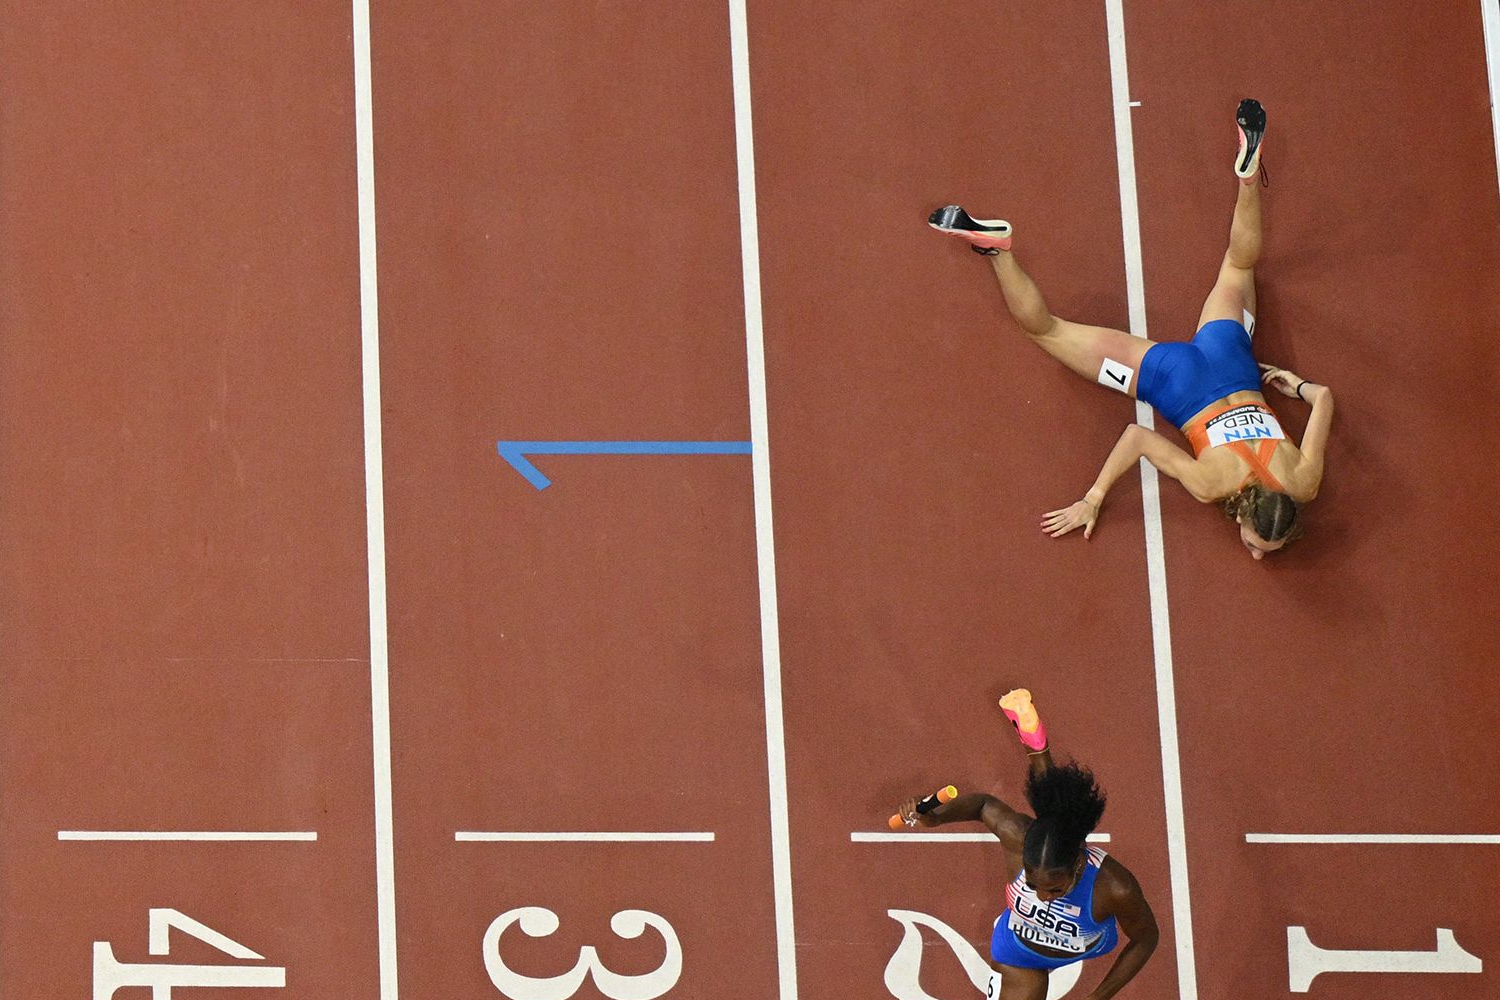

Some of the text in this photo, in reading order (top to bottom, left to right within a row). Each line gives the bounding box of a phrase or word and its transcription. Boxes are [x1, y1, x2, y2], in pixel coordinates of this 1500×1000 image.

[1105, 369, 1127, 386] 7
[1223, 413, 1265, 429] NED
[1223, 426, 1272, 442] NTN
[1014, 896, 1079, 937] USA
[1287, 926, 1482, 992] 1
[987, 976, 994, 998] 6
